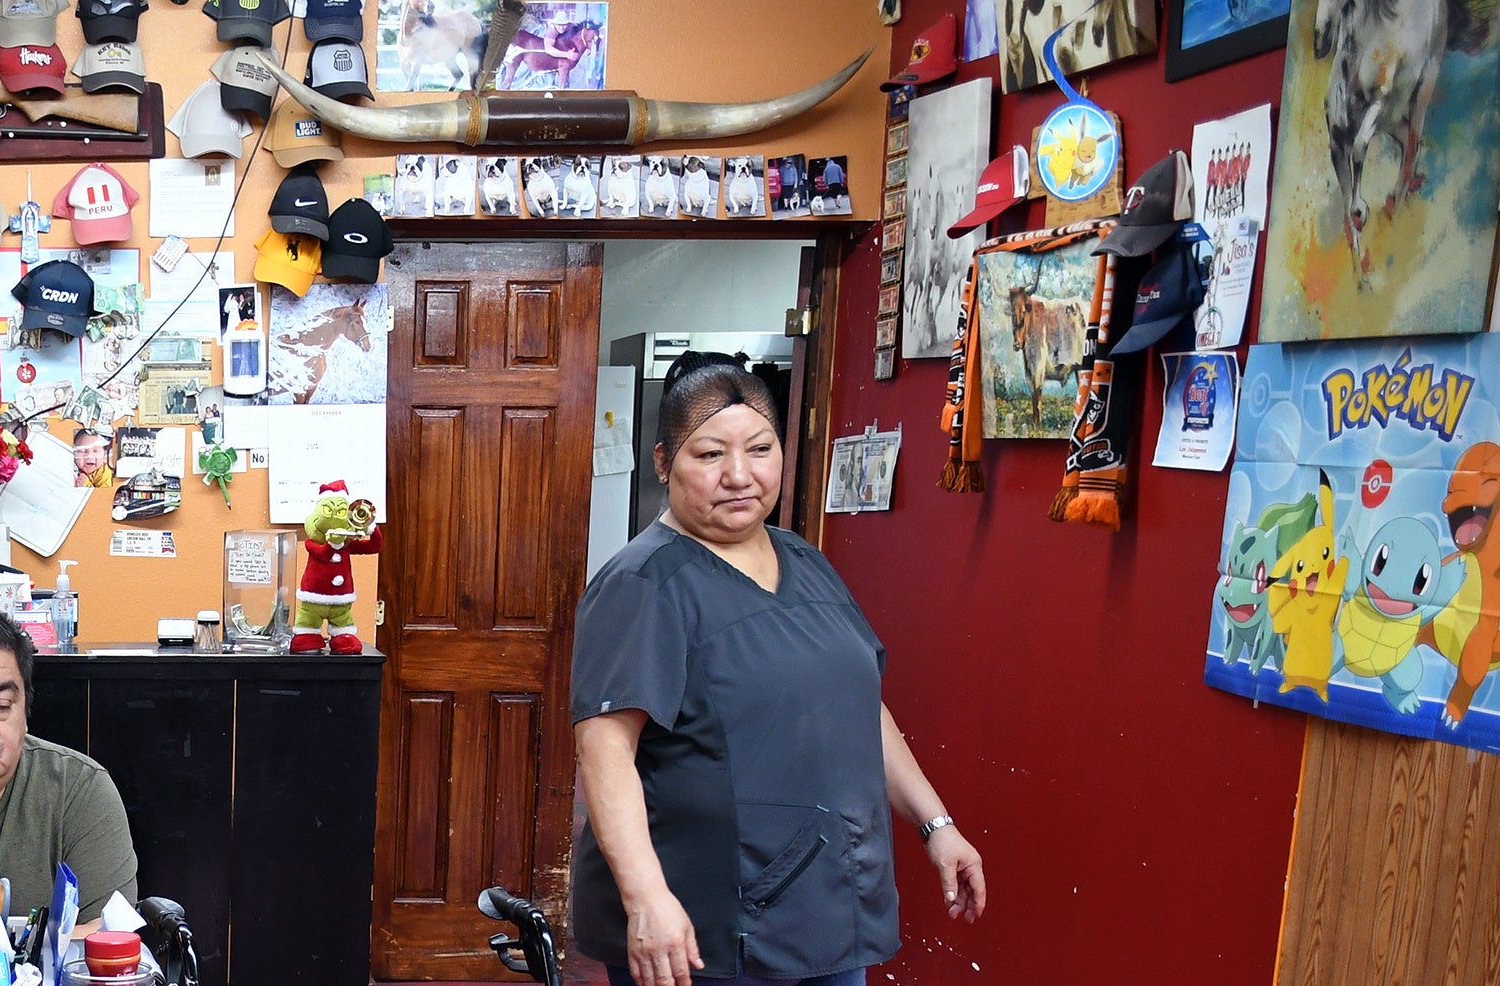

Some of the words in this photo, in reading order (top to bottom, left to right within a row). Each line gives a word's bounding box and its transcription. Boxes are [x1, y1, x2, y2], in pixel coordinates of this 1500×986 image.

[299, 121, 317, 129] BUD
[296, 128, 321, 137] LIGHT
[88, 205, 113, 215] PERU
[1227, 238, 1255, 263] Jisa's
[41, 287, 79, 304] CRDN
[252, 453, 265, 463] No
